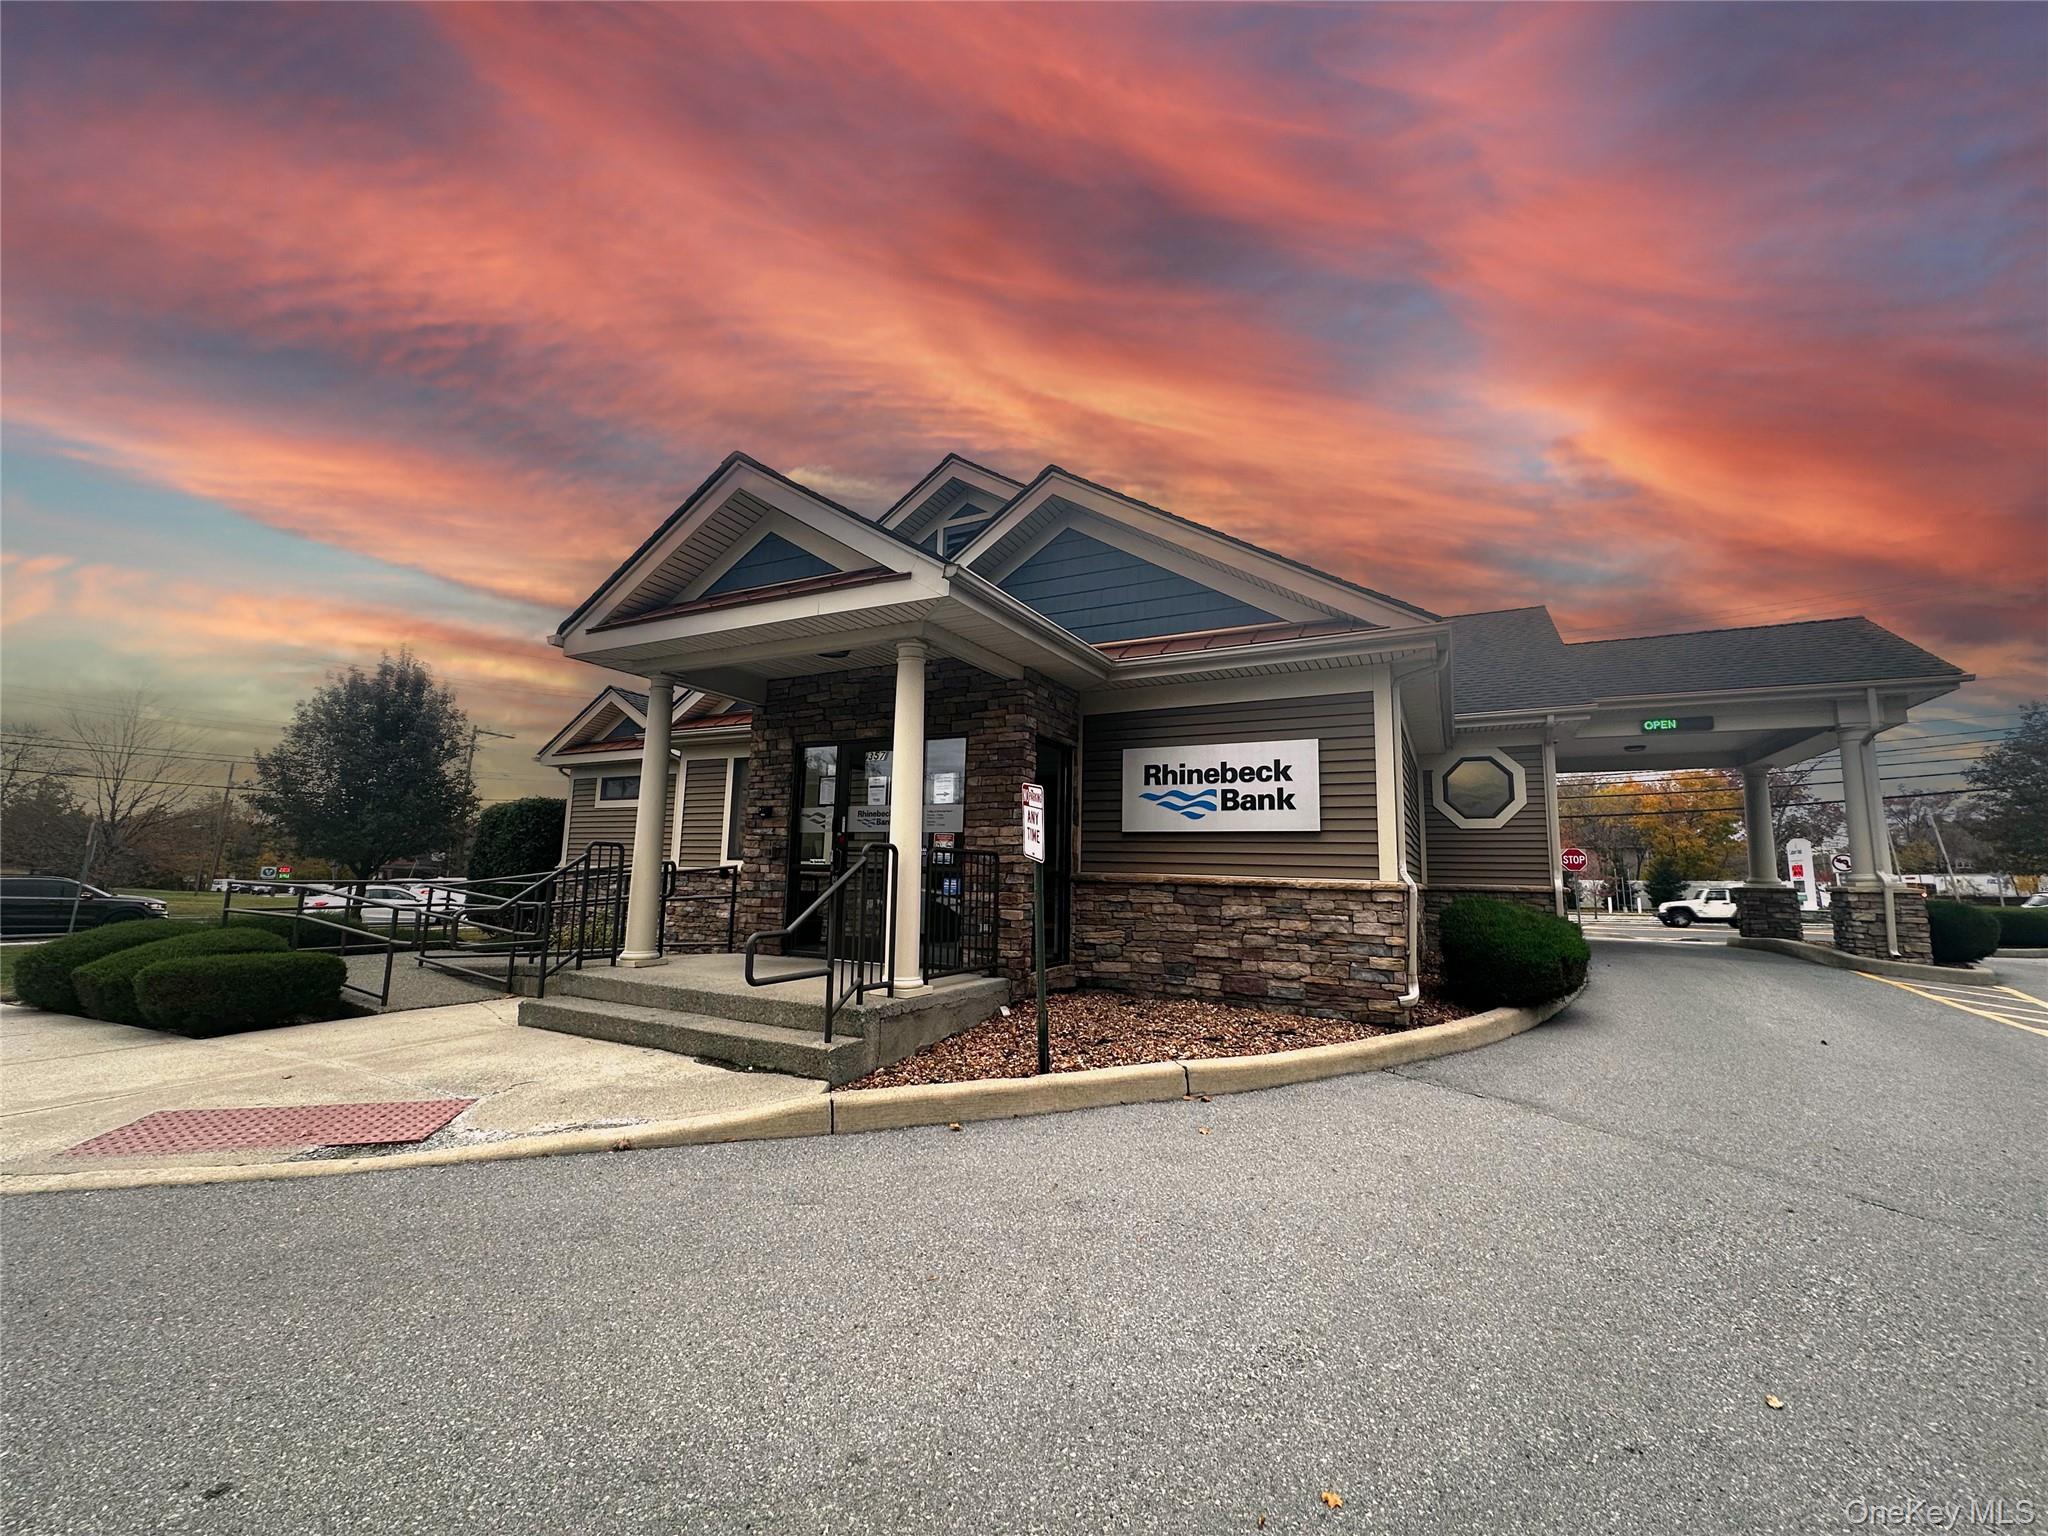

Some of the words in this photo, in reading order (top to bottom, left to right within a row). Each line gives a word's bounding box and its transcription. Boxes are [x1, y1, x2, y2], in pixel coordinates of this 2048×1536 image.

[1643, 719, 1677, 730] OPEN
[1143, 759, 1294, 786] Rhinebeck
[1220, 787, 1297, 812] Bank
[857, 809, 891, 818] Rhinebec
[1027, 809, 1040, 826] ANY
[1027, 826, 1040, 844] TIME
[1562, 855, 1586, 865] STOP
